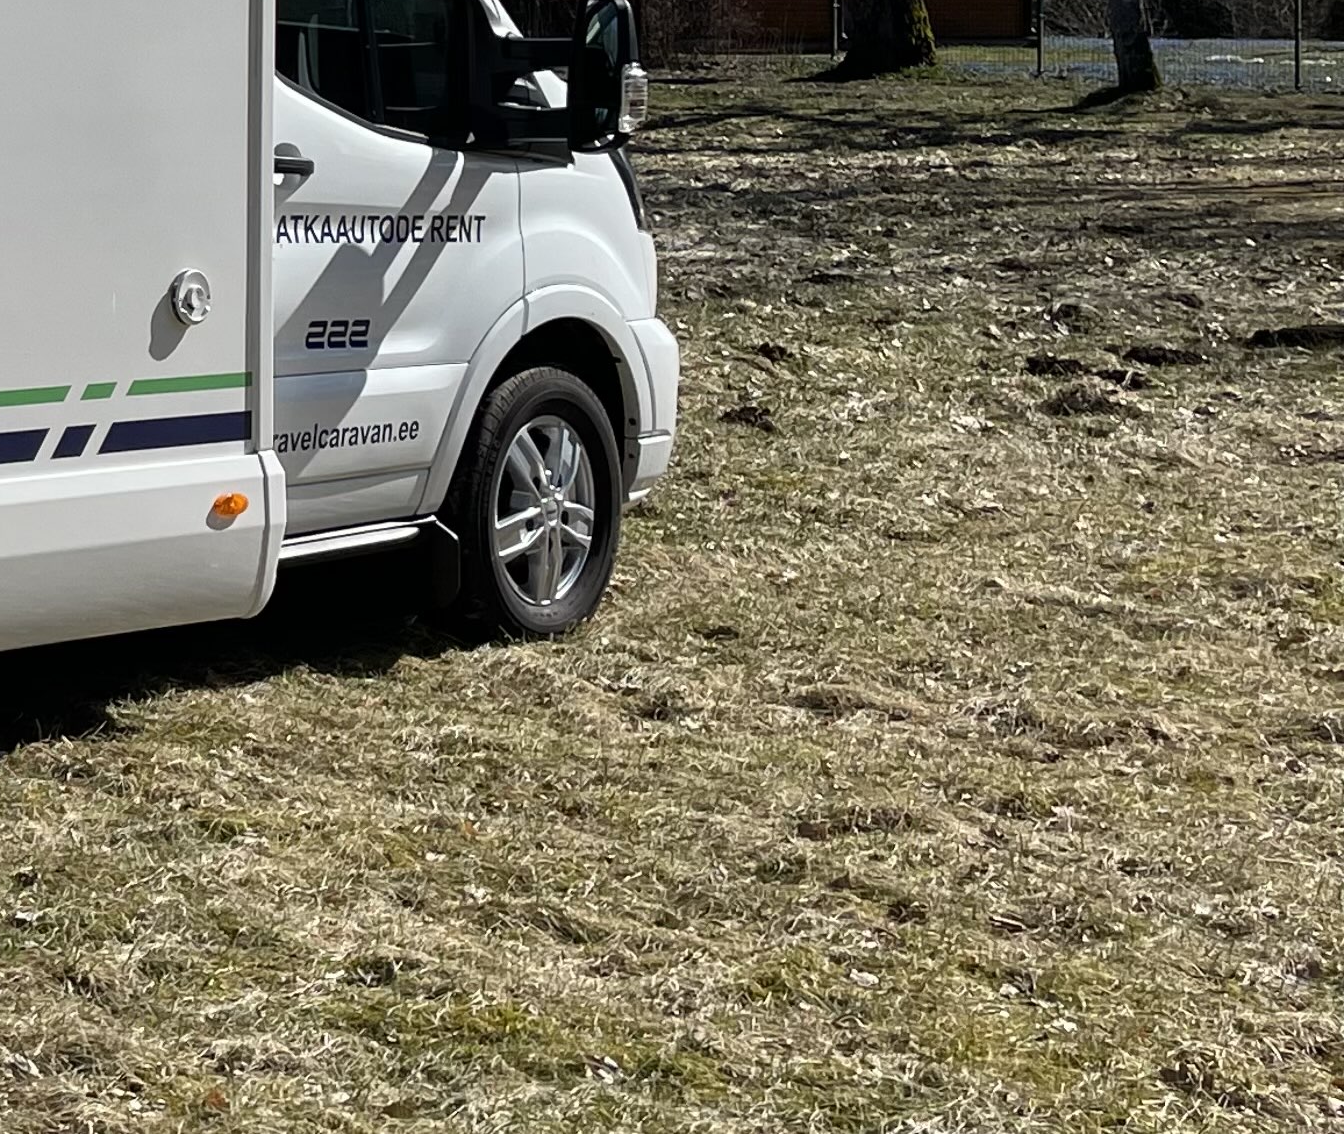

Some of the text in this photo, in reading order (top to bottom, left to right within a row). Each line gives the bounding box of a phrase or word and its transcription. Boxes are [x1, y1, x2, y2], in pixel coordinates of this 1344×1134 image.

[275, 214, 486, 244] ATKAAUTODE RENT
[305, 319, 371, 350] 222
[272, 419, 420, 454] ravelcaravan.ee
